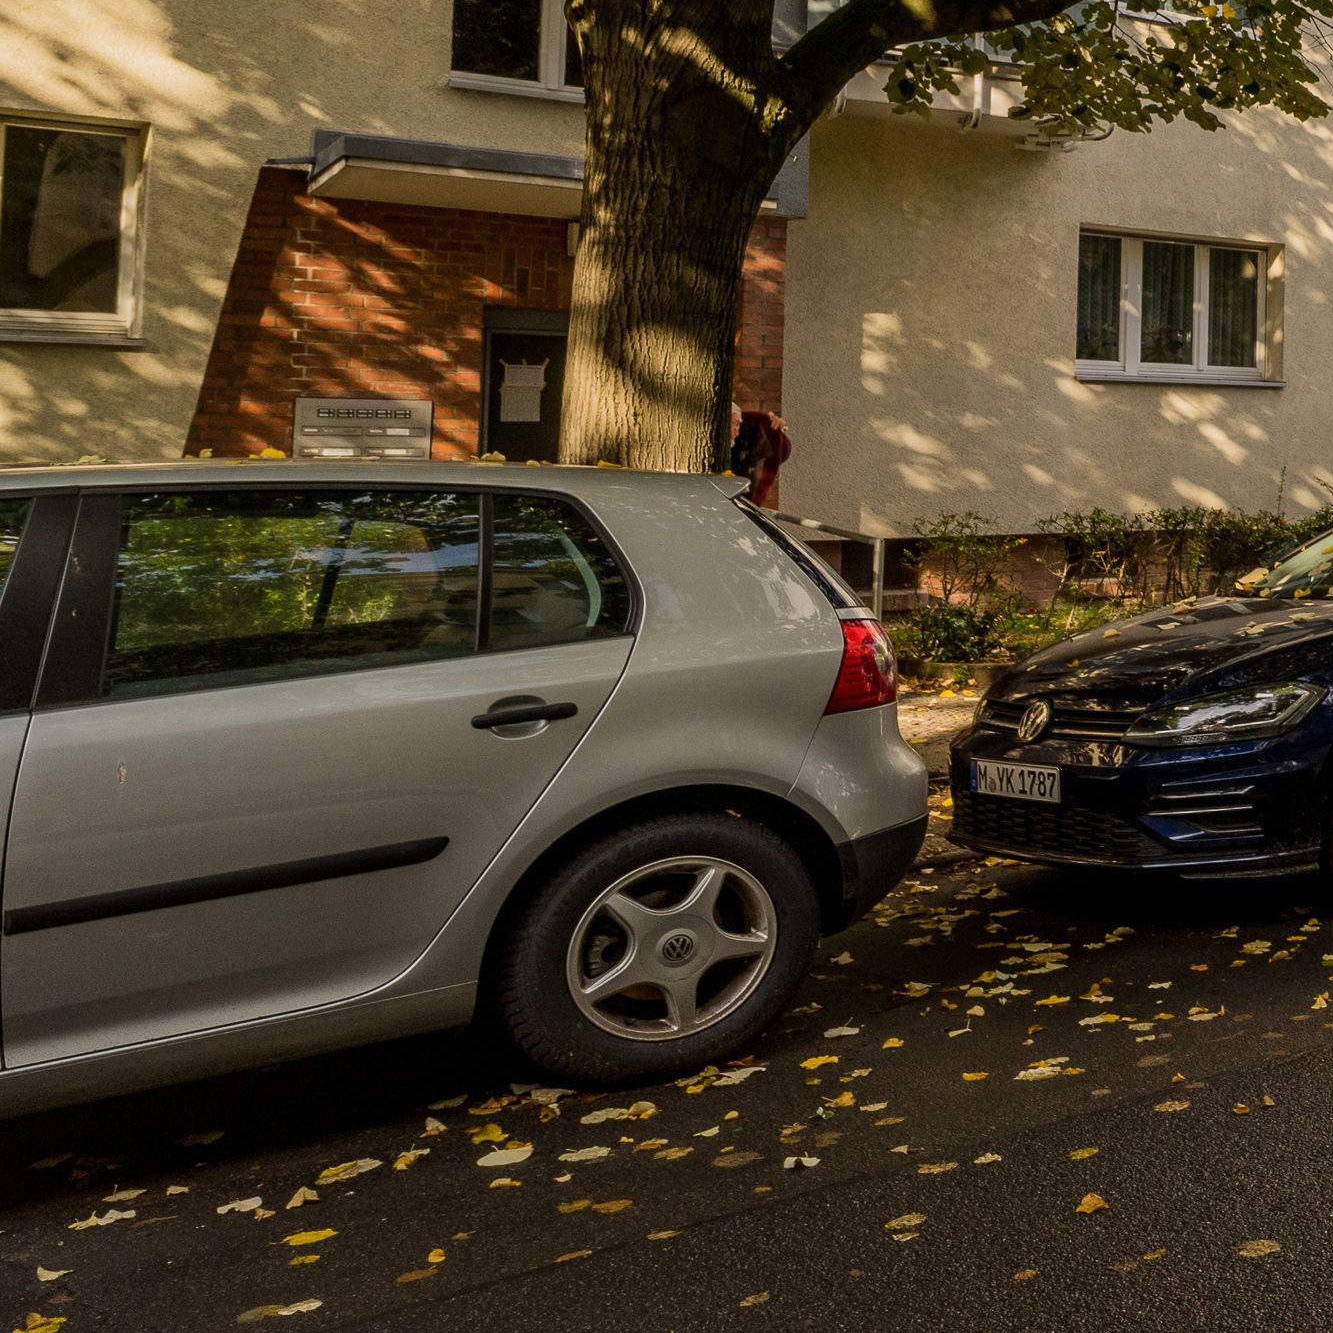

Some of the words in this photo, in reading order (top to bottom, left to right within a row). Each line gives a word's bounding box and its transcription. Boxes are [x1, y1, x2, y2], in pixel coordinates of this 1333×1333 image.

[978, 764, 988, 789] M
[996, 766, 1015, 794] YK
[1018, 769, 1057, 798] 1787
[662, 933, 694, 962] VW
